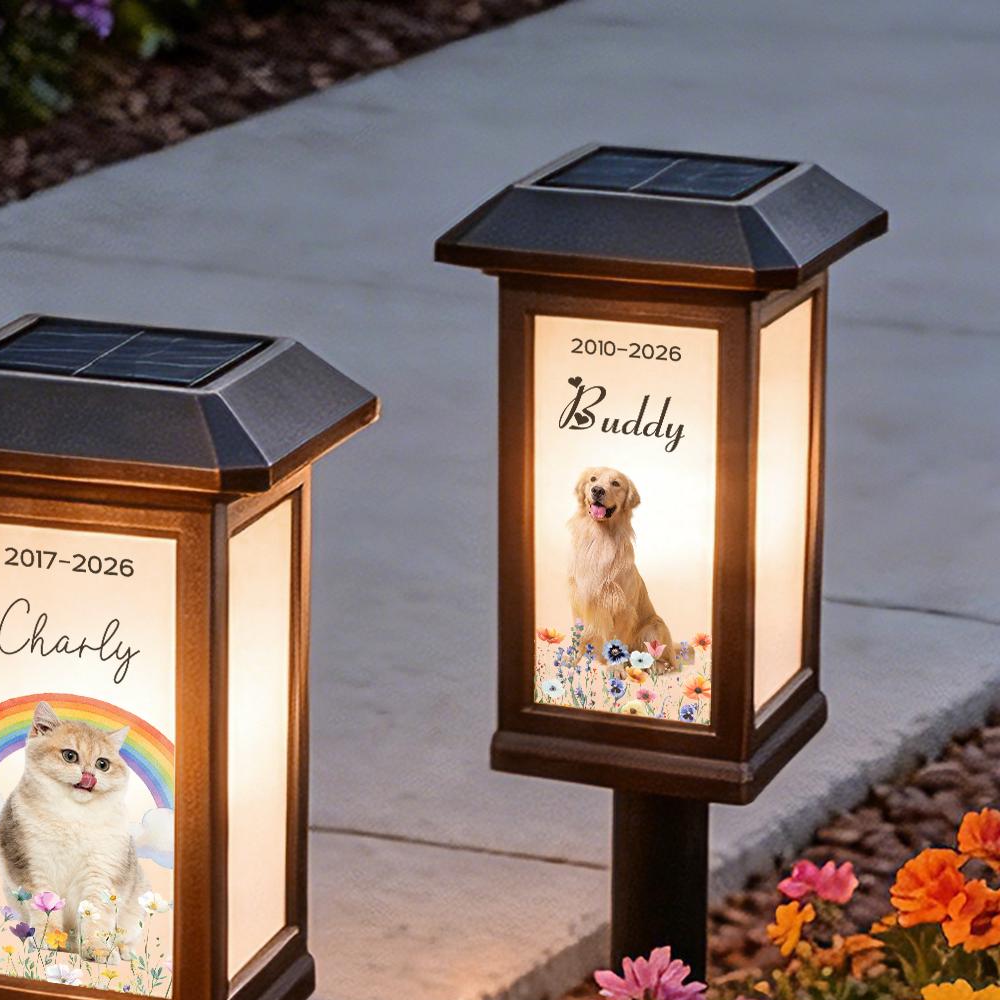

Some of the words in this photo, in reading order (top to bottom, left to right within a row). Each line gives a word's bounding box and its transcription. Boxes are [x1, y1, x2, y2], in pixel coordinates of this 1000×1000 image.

[571, 338, 682, 361] 2010-2026
[558, 376, 685, 452] Buddy
[4, 547, 135, 577] 2017-2026
